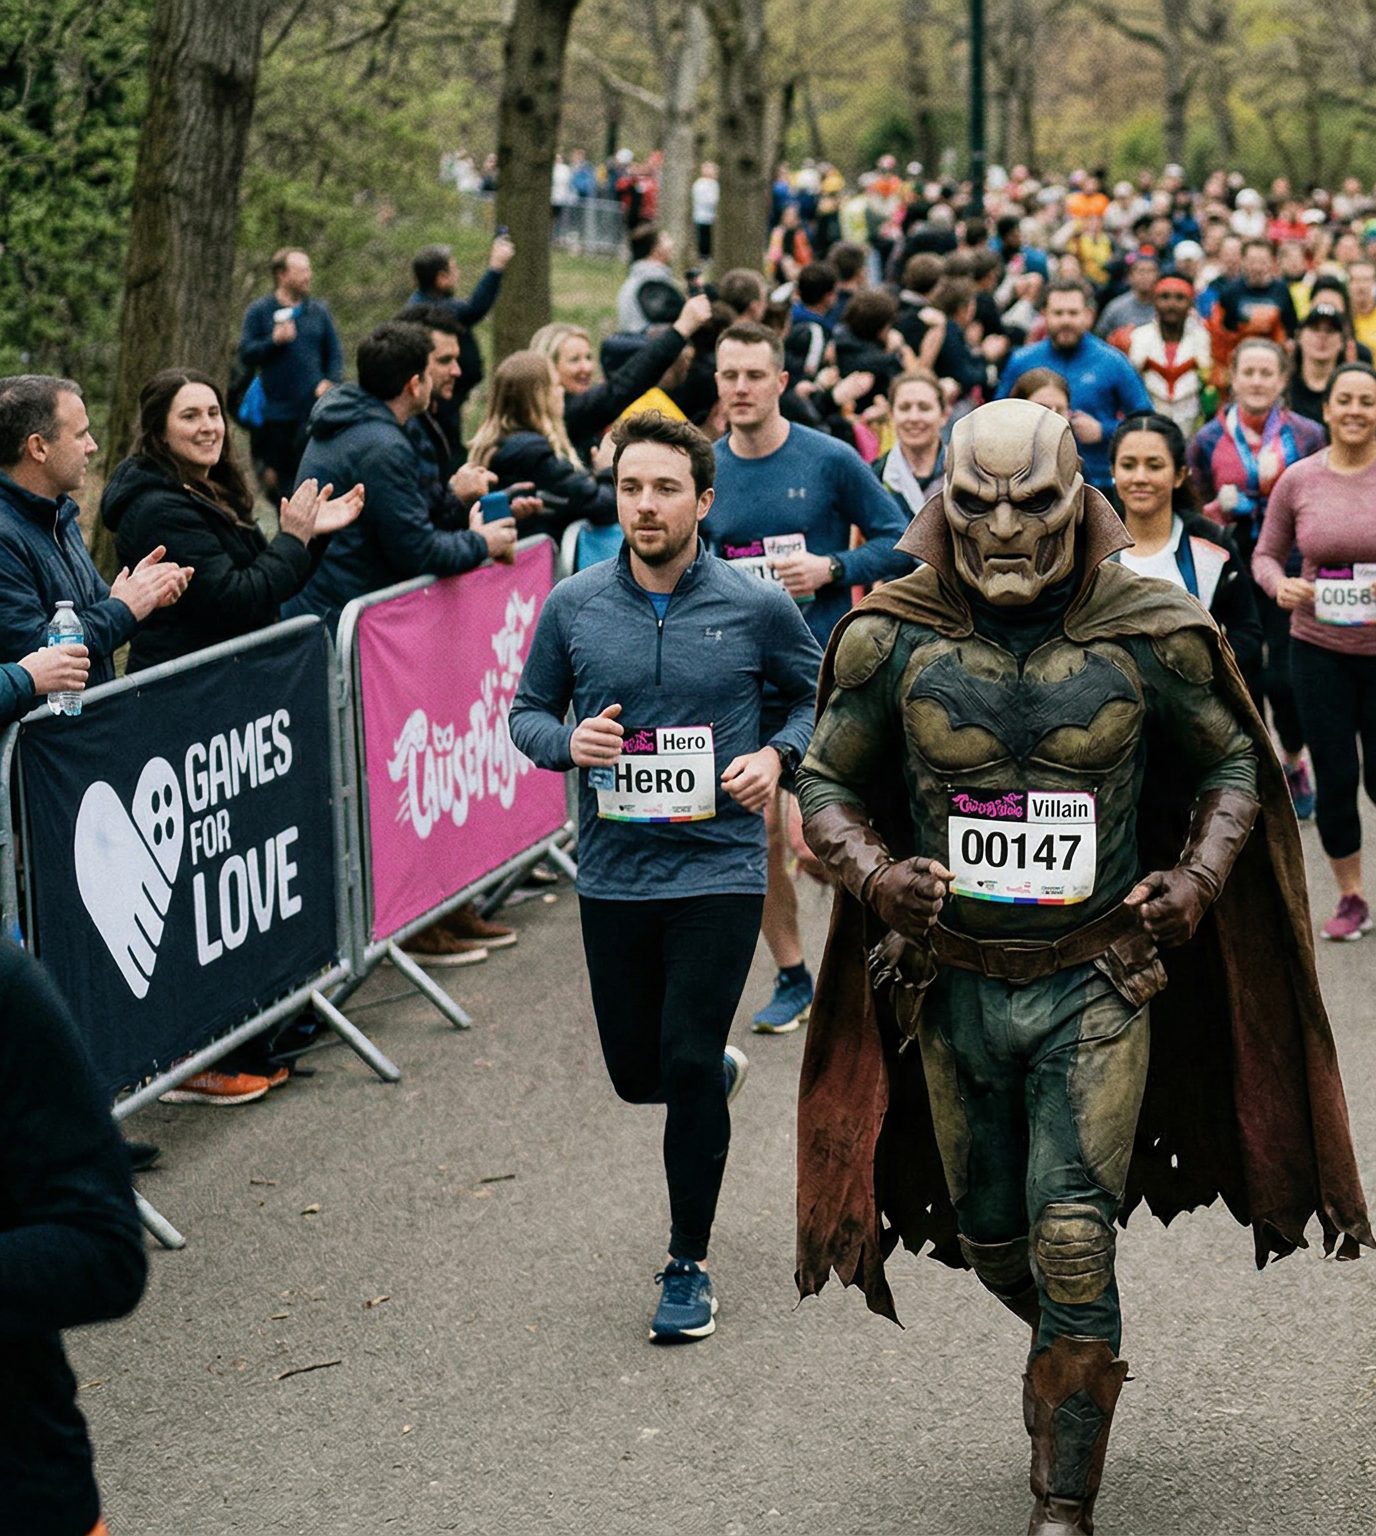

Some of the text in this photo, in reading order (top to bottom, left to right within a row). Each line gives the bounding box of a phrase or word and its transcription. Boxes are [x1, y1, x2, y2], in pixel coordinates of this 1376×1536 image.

[184, 708, 293, 813] GAMES
[663, 733, 706, 751] Hero
[1032, 799, 1088, 818] Villain
[189, 809, 232, 866] FOR
[961, 828, 1082, 871] 00147
[193, 825, 303, 967] LOVE
